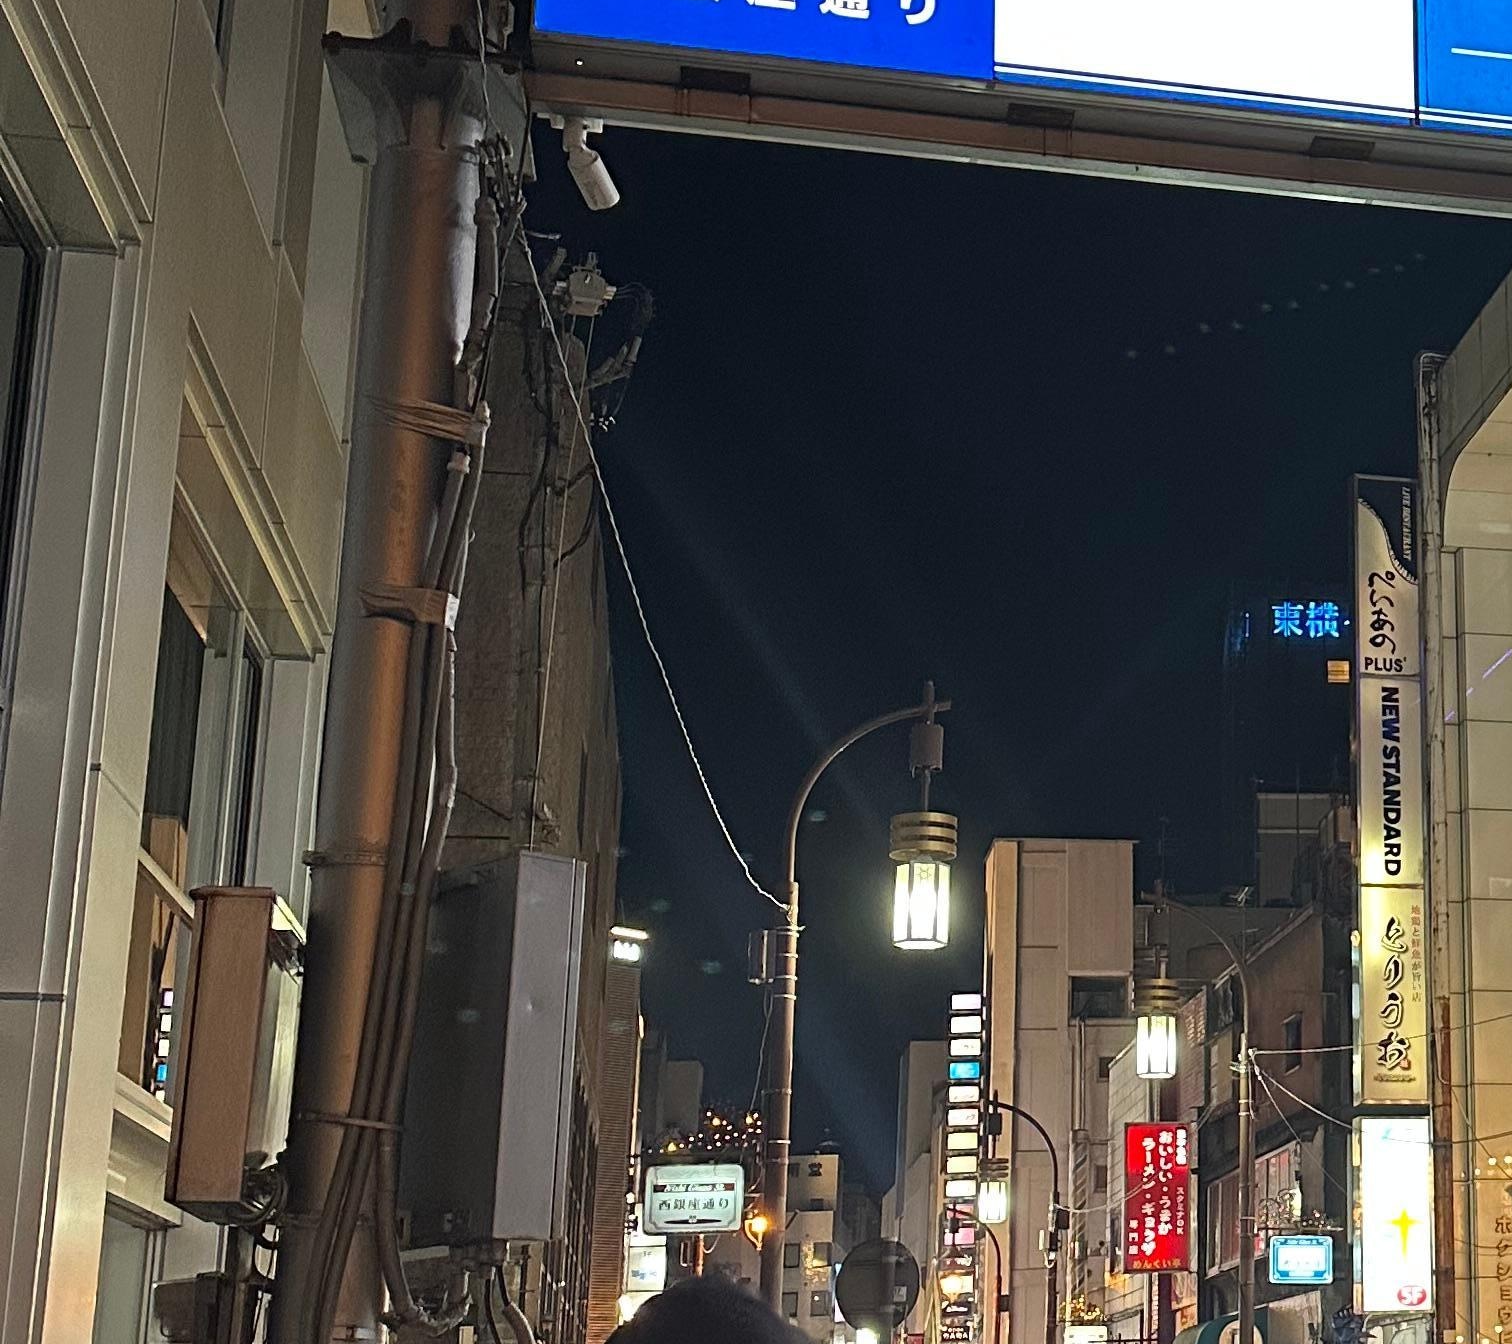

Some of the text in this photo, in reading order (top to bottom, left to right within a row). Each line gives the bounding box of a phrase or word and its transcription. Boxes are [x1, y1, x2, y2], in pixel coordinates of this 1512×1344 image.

[1271, 601, 1340, 638] 東横
[1381, 686, 1403, 877] NEW STANDARD
